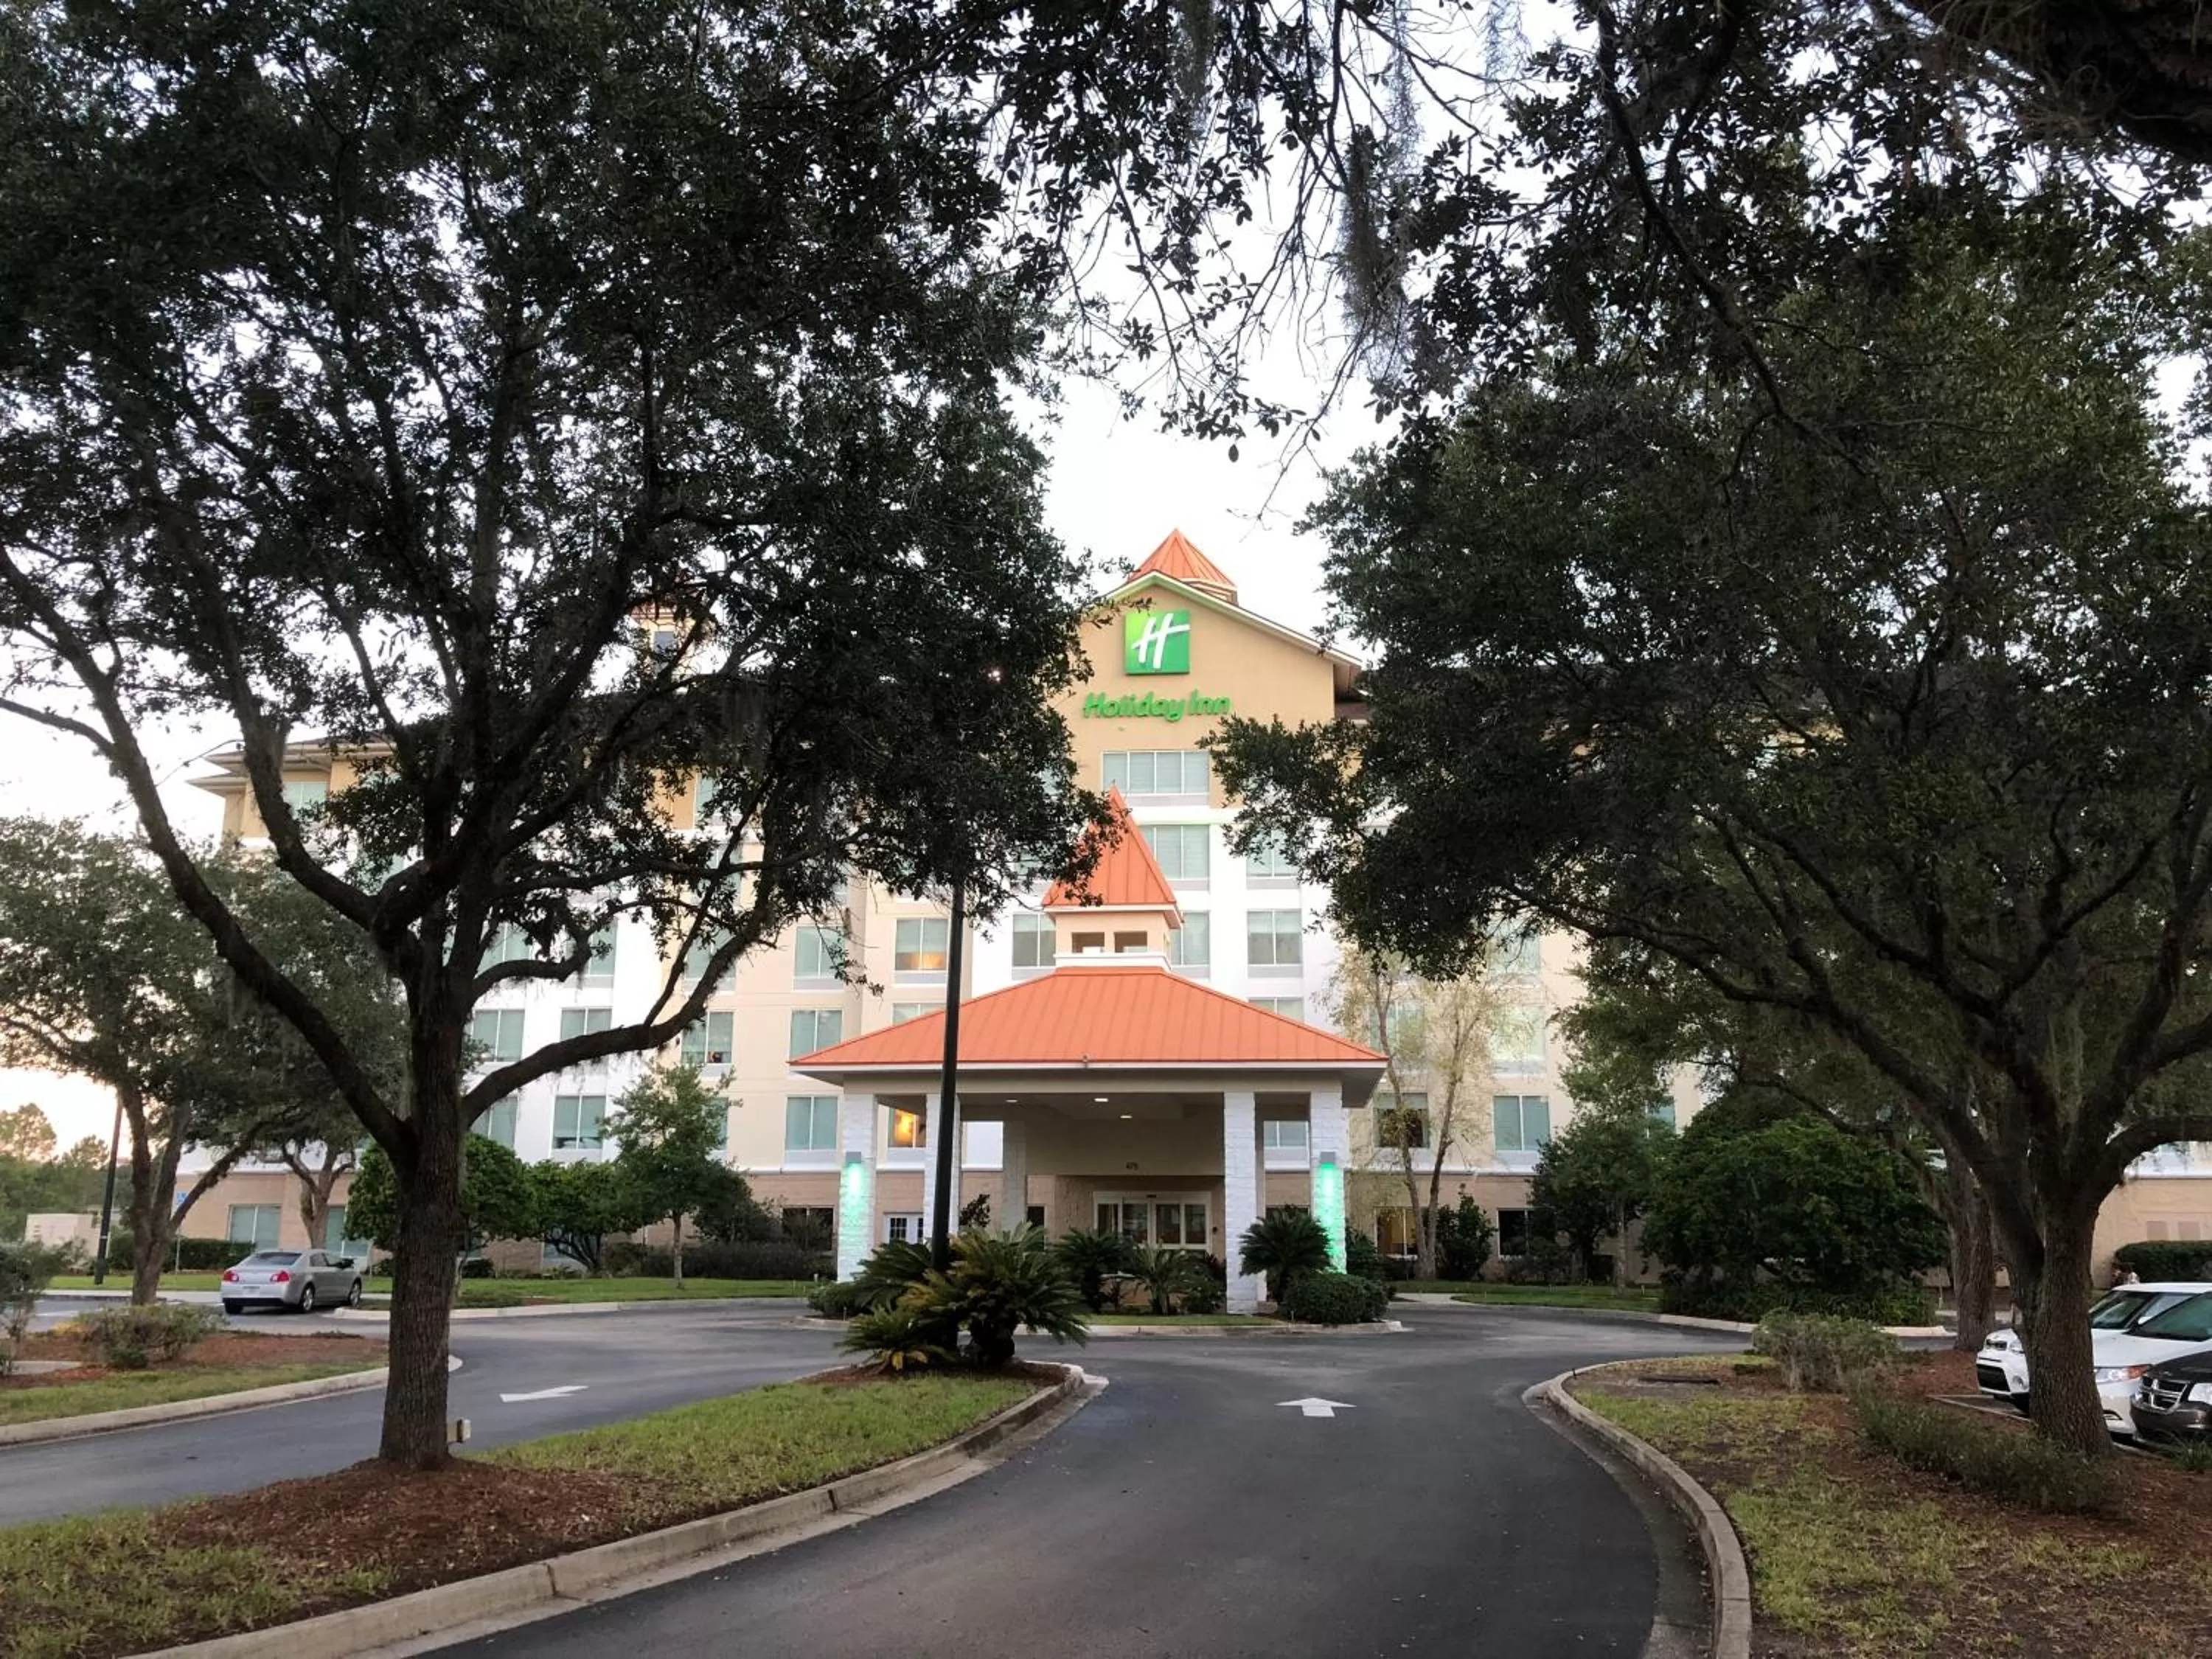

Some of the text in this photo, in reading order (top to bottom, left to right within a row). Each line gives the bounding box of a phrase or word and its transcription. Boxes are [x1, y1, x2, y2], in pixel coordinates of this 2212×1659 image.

[1130, 613, 1191, 669] H
[1083, 689, 1231, 722] Holiday Inn
